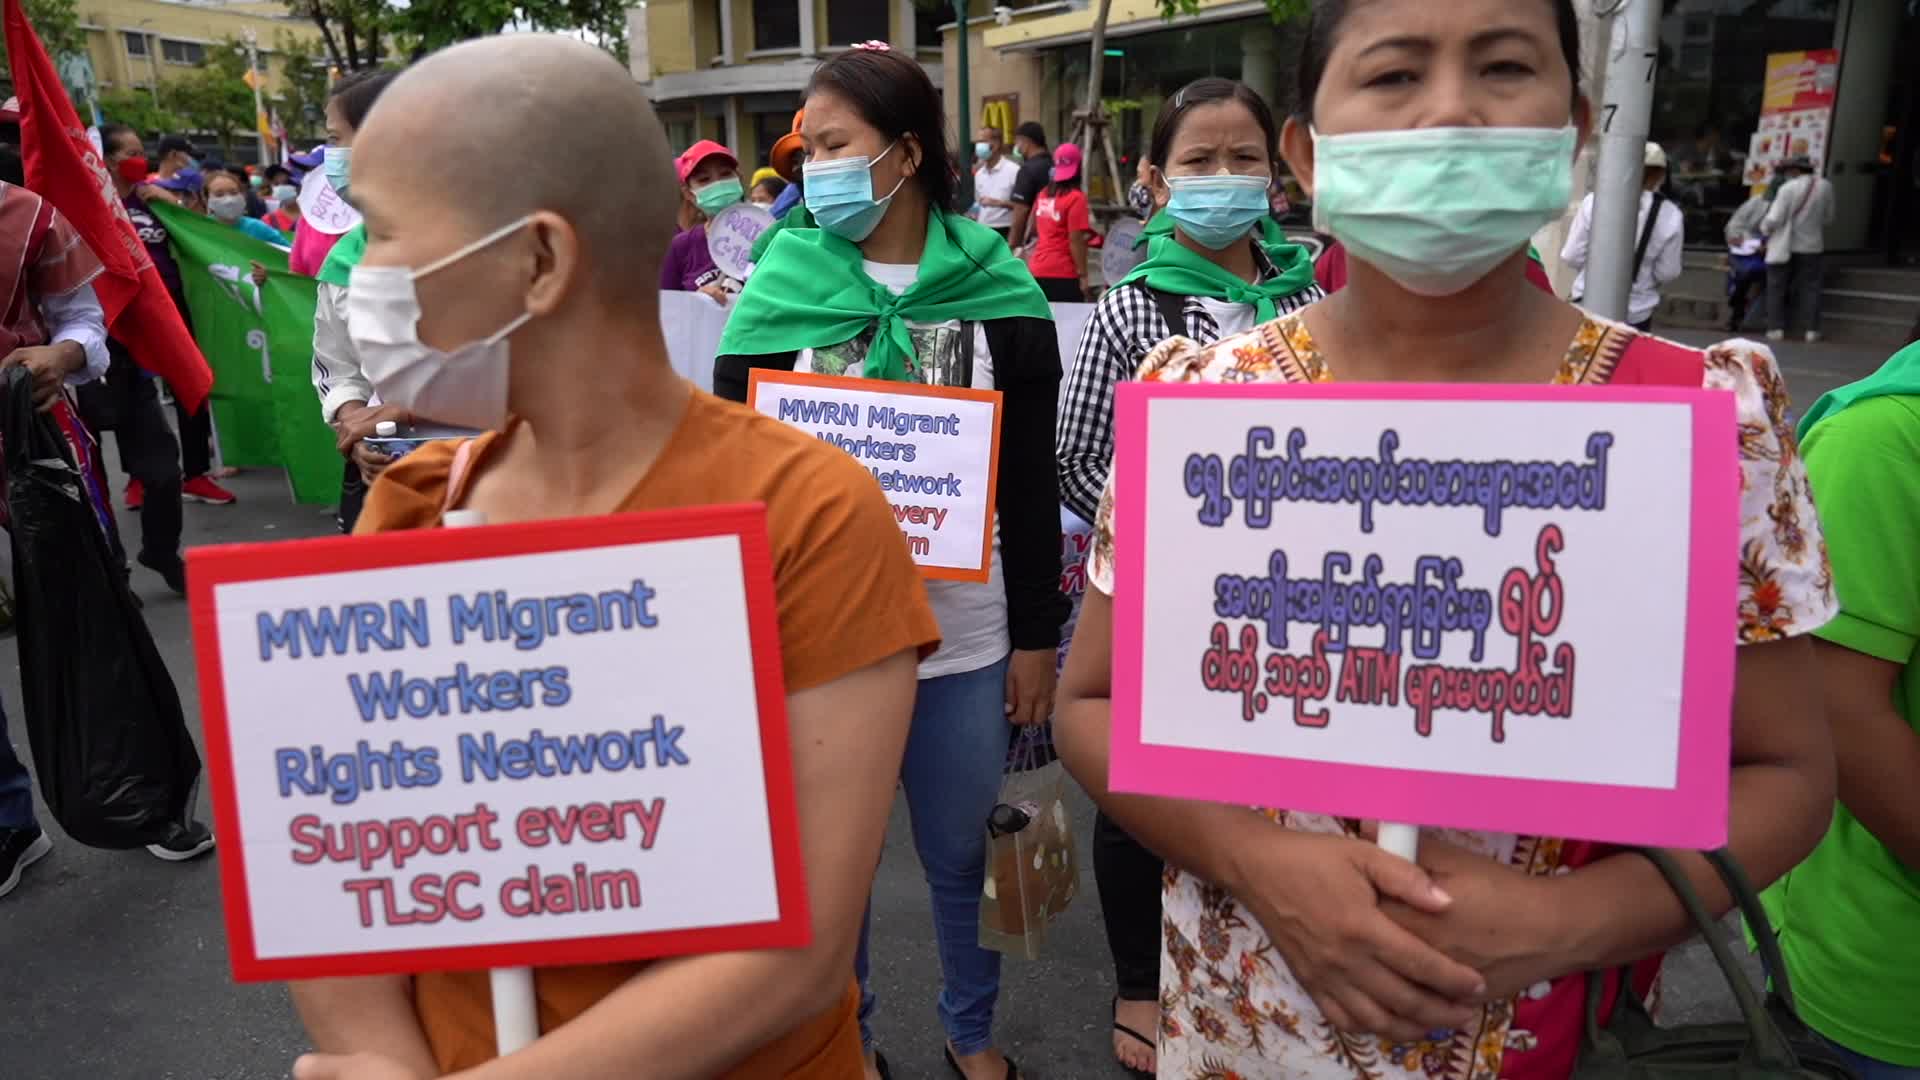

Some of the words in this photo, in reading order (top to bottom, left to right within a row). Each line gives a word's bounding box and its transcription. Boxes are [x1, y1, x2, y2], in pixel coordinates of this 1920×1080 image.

[1603, 104, 1618, 133] 7
[778, 397, 859, 427] MWRN
[867, 405, 960, 436] Migrant
[889, 503, 948, 531] very
[256, 597, 430, 661] MWRN
[449, 579, 659, 650] Migrant
[1499, 523, 1564, 673] ရပ်
[347, 662, 571, 722] Workers
[1336, 647, 1400, 706] ATM
[275, 741, 442, 804] Rights
[457, 715, 690, 784] Network
[289, 804, 500, 870] Support
[516, 798, 666, 849] every
[344, 872, 484, 928] TLSC
[499, 863, 641, 918] claim
